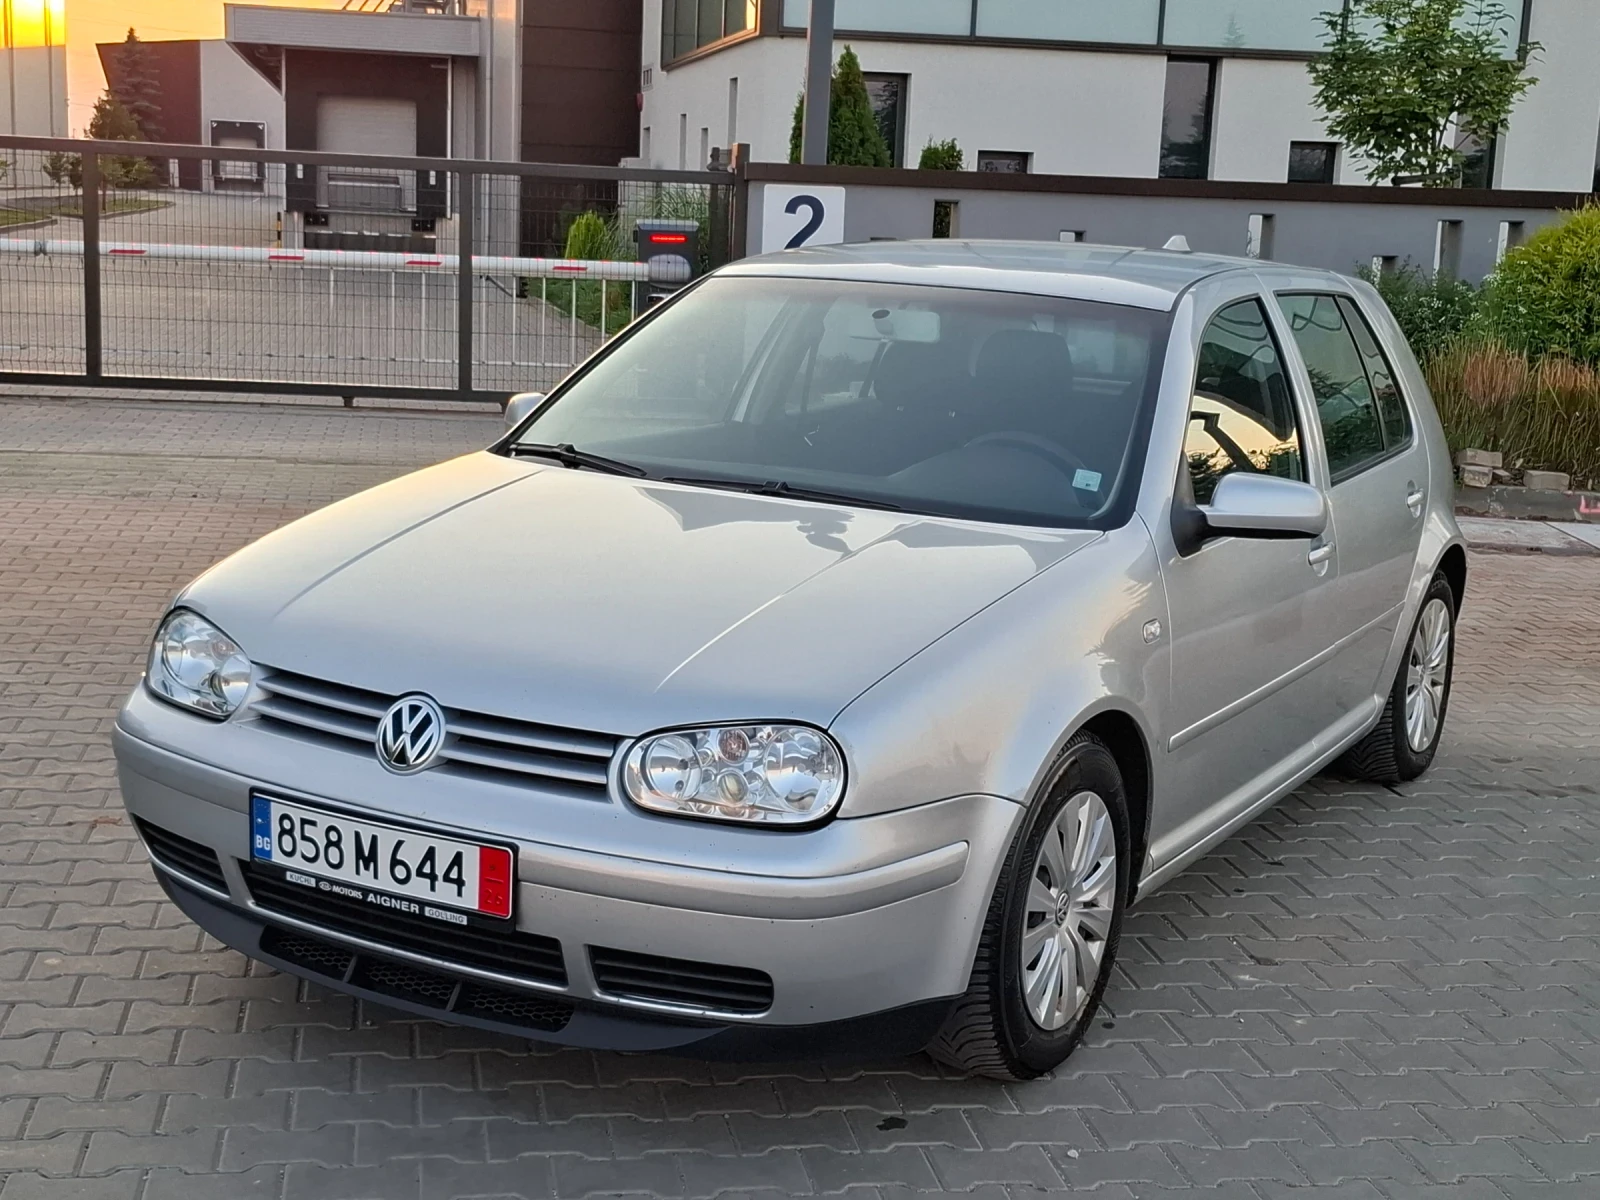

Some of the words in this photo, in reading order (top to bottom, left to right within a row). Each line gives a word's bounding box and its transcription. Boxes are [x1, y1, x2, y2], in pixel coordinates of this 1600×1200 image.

[783, 194, 825, 250] 2
[379, 700, 439, 767] VW
[256, 834, 271, 851] BG
[277, 812, 345, 870] 858
[354, 829, 379, 880] M
[389, 839, 466, 898] 644
[332, 885, 363, 899] MOTORS
[367, 893, 419, 914] AIGNER
[428, 908, 464, 923] GOLLING
